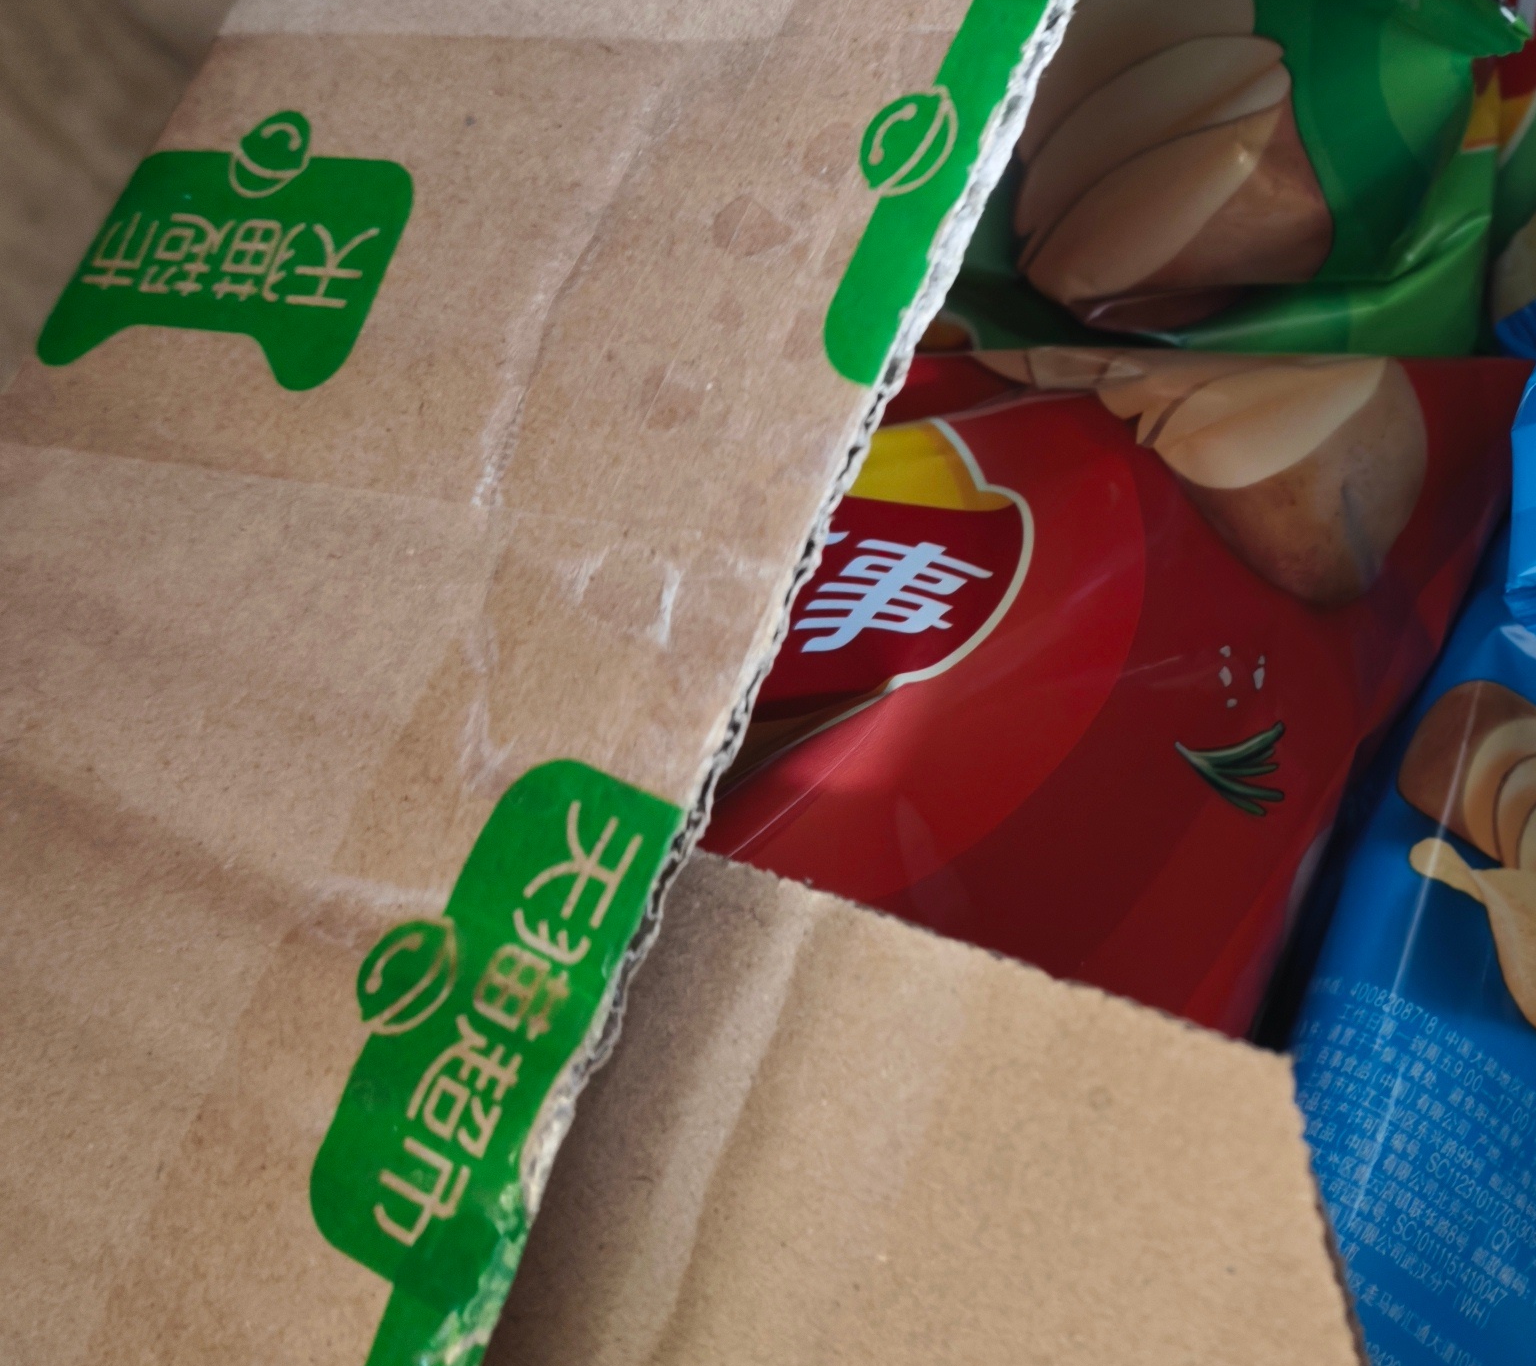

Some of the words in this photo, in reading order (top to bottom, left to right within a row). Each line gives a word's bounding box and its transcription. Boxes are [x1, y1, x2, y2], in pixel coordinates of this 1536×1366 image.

[80, 211, 380, 309] 天猫超市
[793, 532, 993, 653] 事
[373, 799, 643, 1248] 天猫超市
